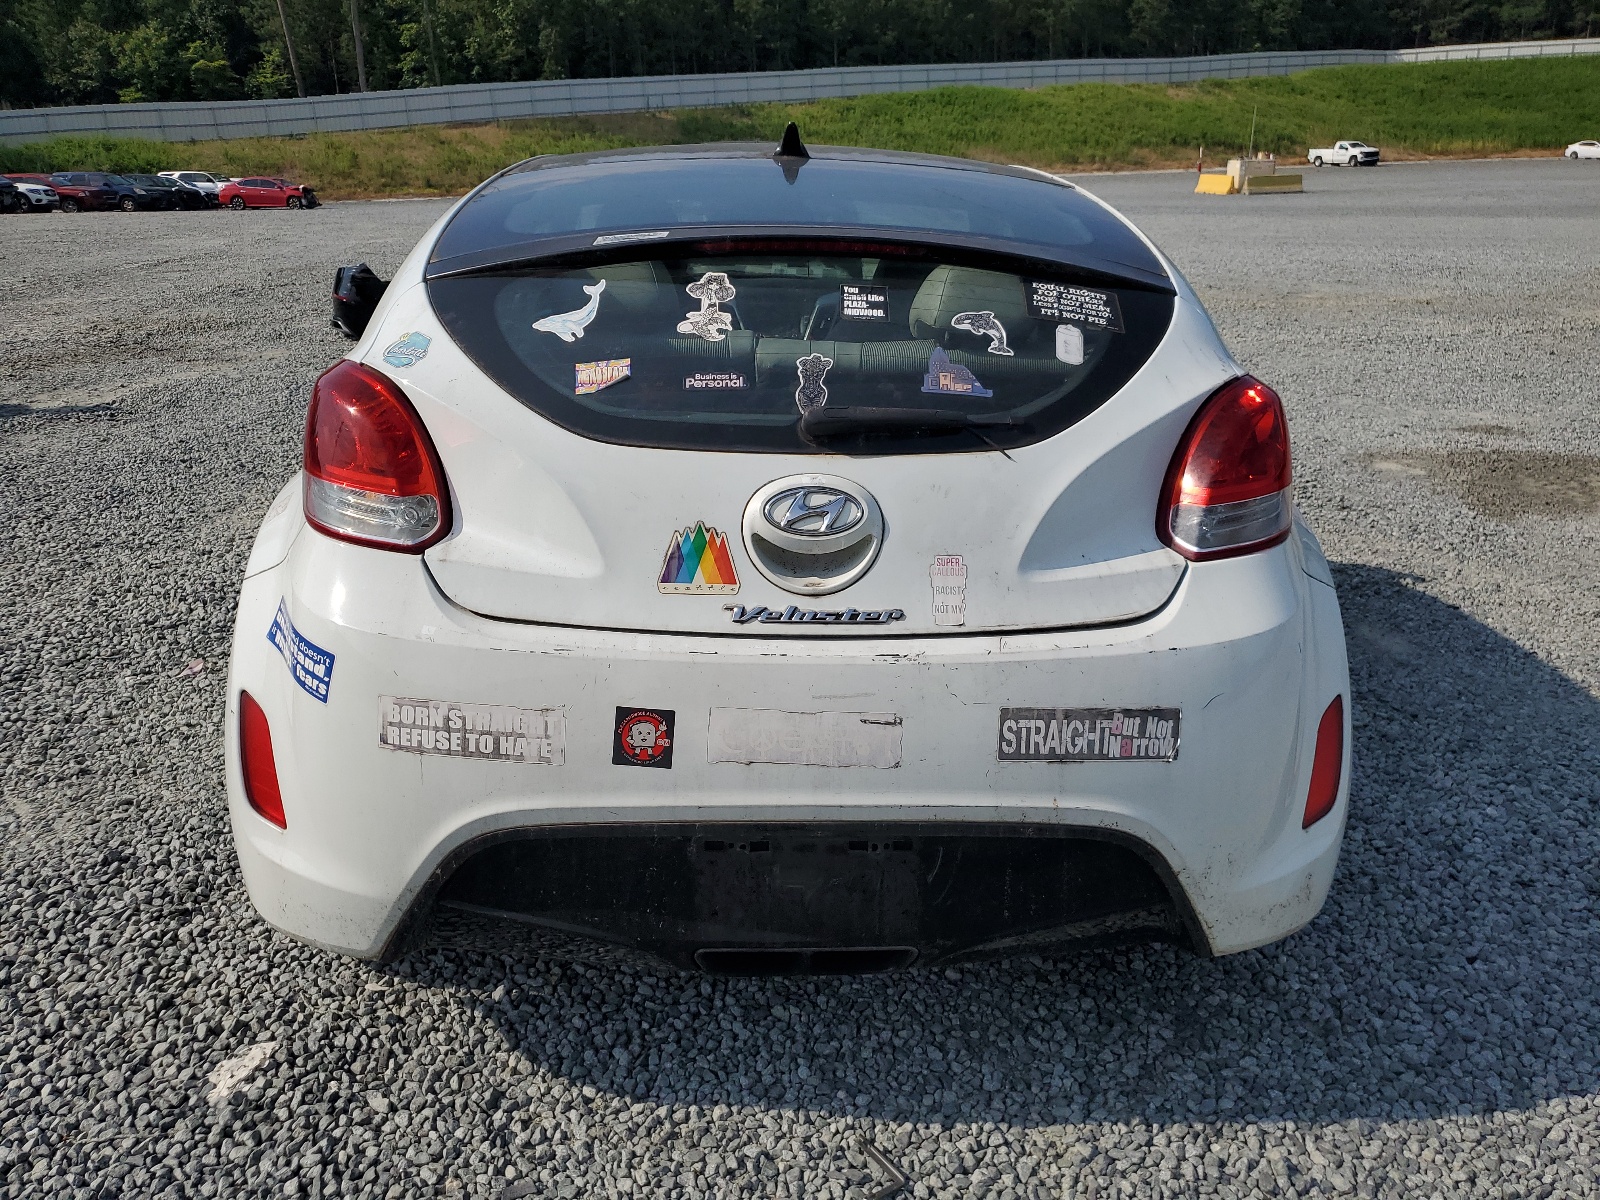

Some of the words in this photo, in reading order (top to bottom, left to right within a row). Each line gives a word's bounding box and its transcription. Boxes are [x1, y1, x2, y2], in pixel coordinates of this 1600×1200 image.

[843, 286, 859, 294] You
[1032, 282, 1067, 293] EQUAL
[1068, 288, 1107, 300] RIGHTS
[1062, 294, 1104, 305] OTHERS
[1060, 299, 1080, 307] NOT
[1083, 303, 1111, 313] MEAN
[843, 308, 886, 317] MIDWOOD.
[1062, 311, 1085, 320] NOT
[686, 376, 747, 388] Personal.
[731, 372, 737, 380] is
[936, 557, 960, 567] SUPER
[935, 585, 961, 596] RACIST
[723, 603, 907, 624] Veloster
[951, 604, 963, 614] MY
[296, 663, 328, 695] fears
[390, 701, 444, 728] BORN
[448, 708, 563, 736] STRAIGHT
[1001, 719, 1113, 755] STRAIGHT
[1111, 712, 1141, 738] But
[1145, 715, 1174, 739] Not
[386, 726, 462, 751] REFUSE
[465, 733, 494, 754] TO
[500, 736, 552, 758] HATE
[1108, 735, 1175, 758] Narrow
